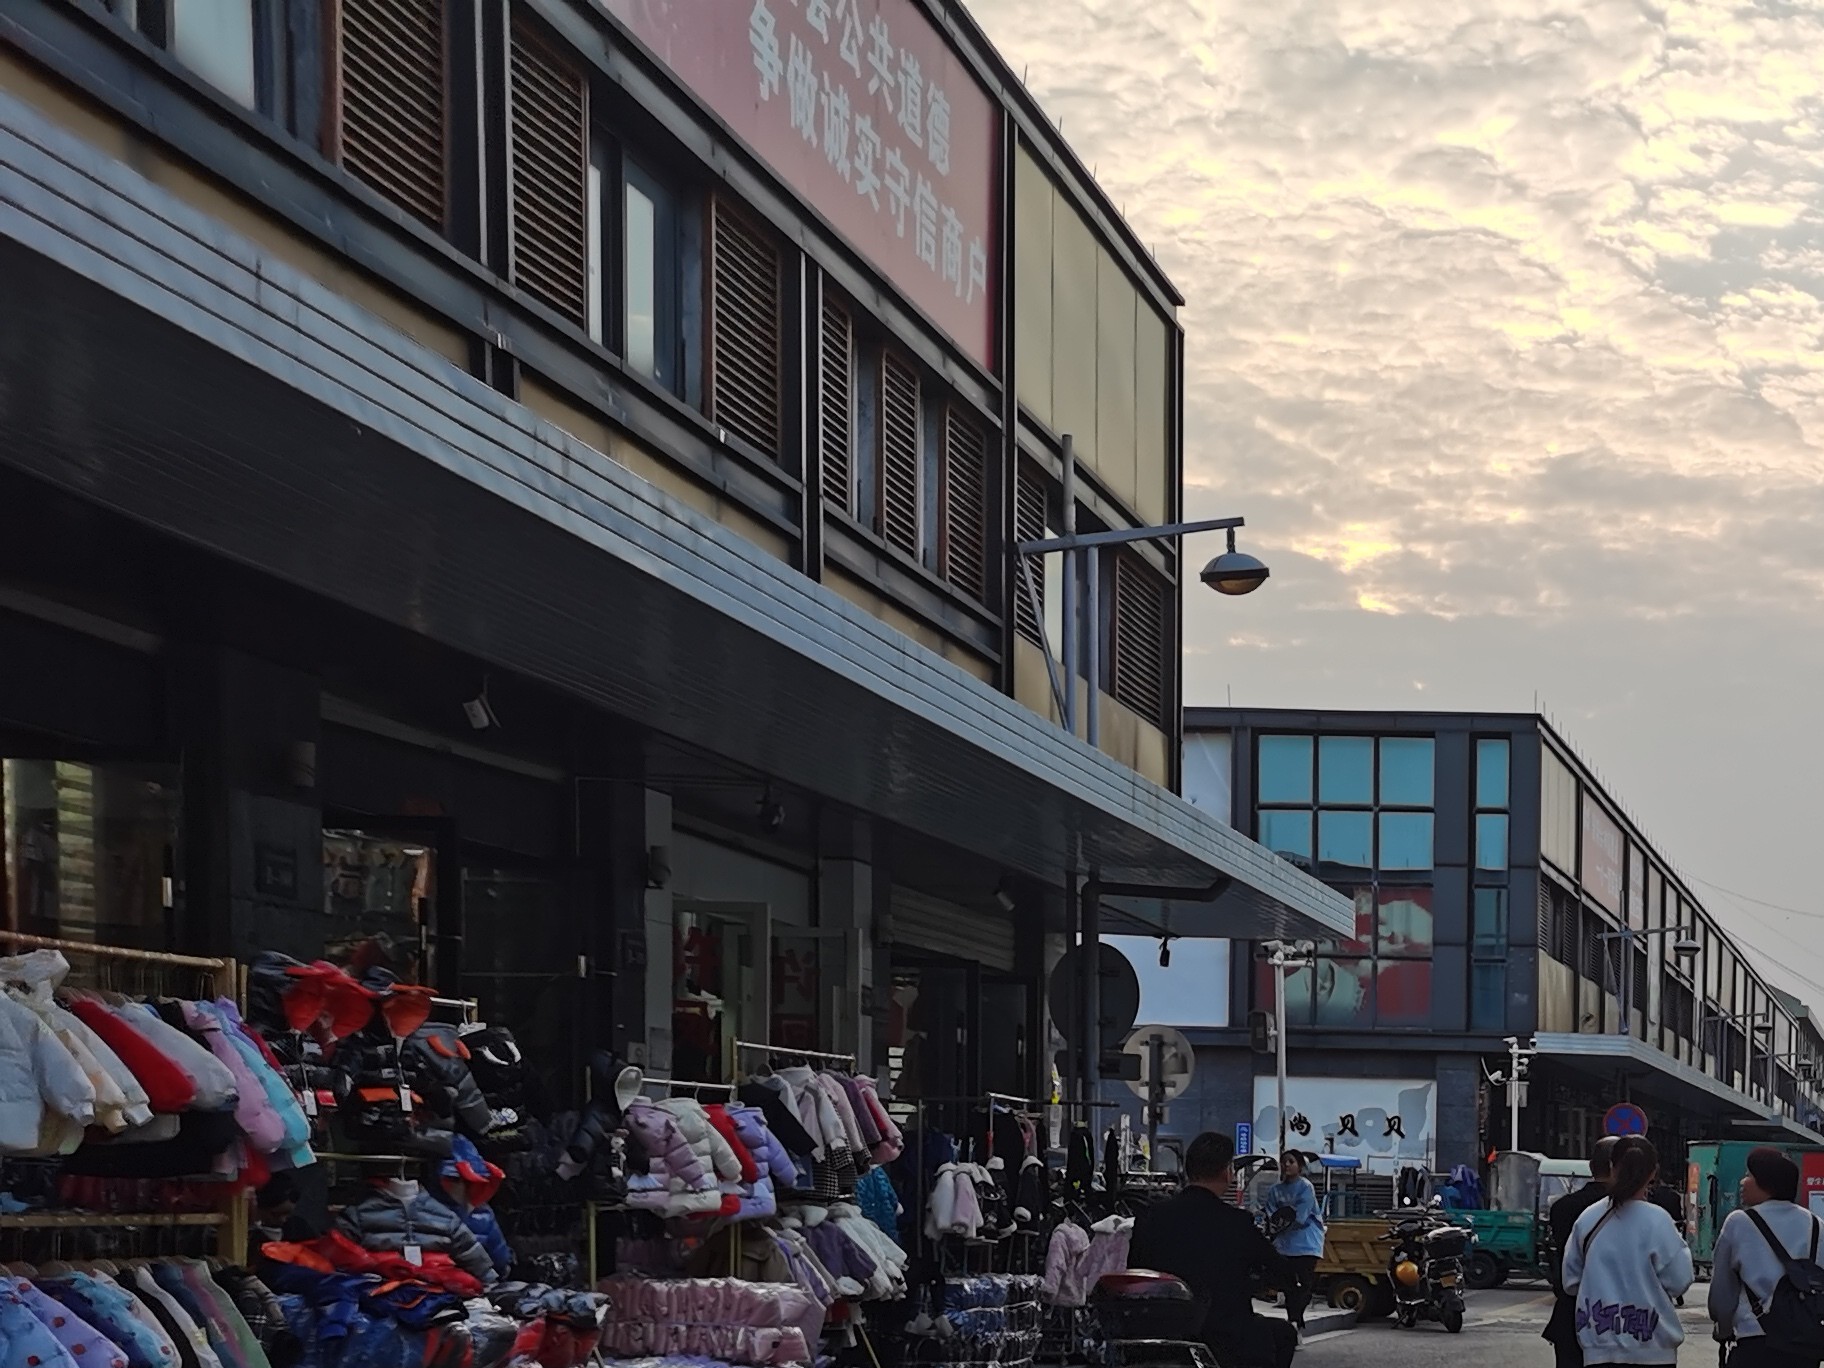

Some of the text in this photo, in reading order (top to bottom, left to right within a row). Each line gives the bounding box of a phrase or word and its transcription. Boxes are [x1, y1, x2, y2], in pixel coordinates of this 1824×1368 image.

[749, 0, 988, 304] 争做诚实守信商户
[790, 0, 951, 177] 公共道德
[1289, 1112, 1405, 1139] 尚贝贝
